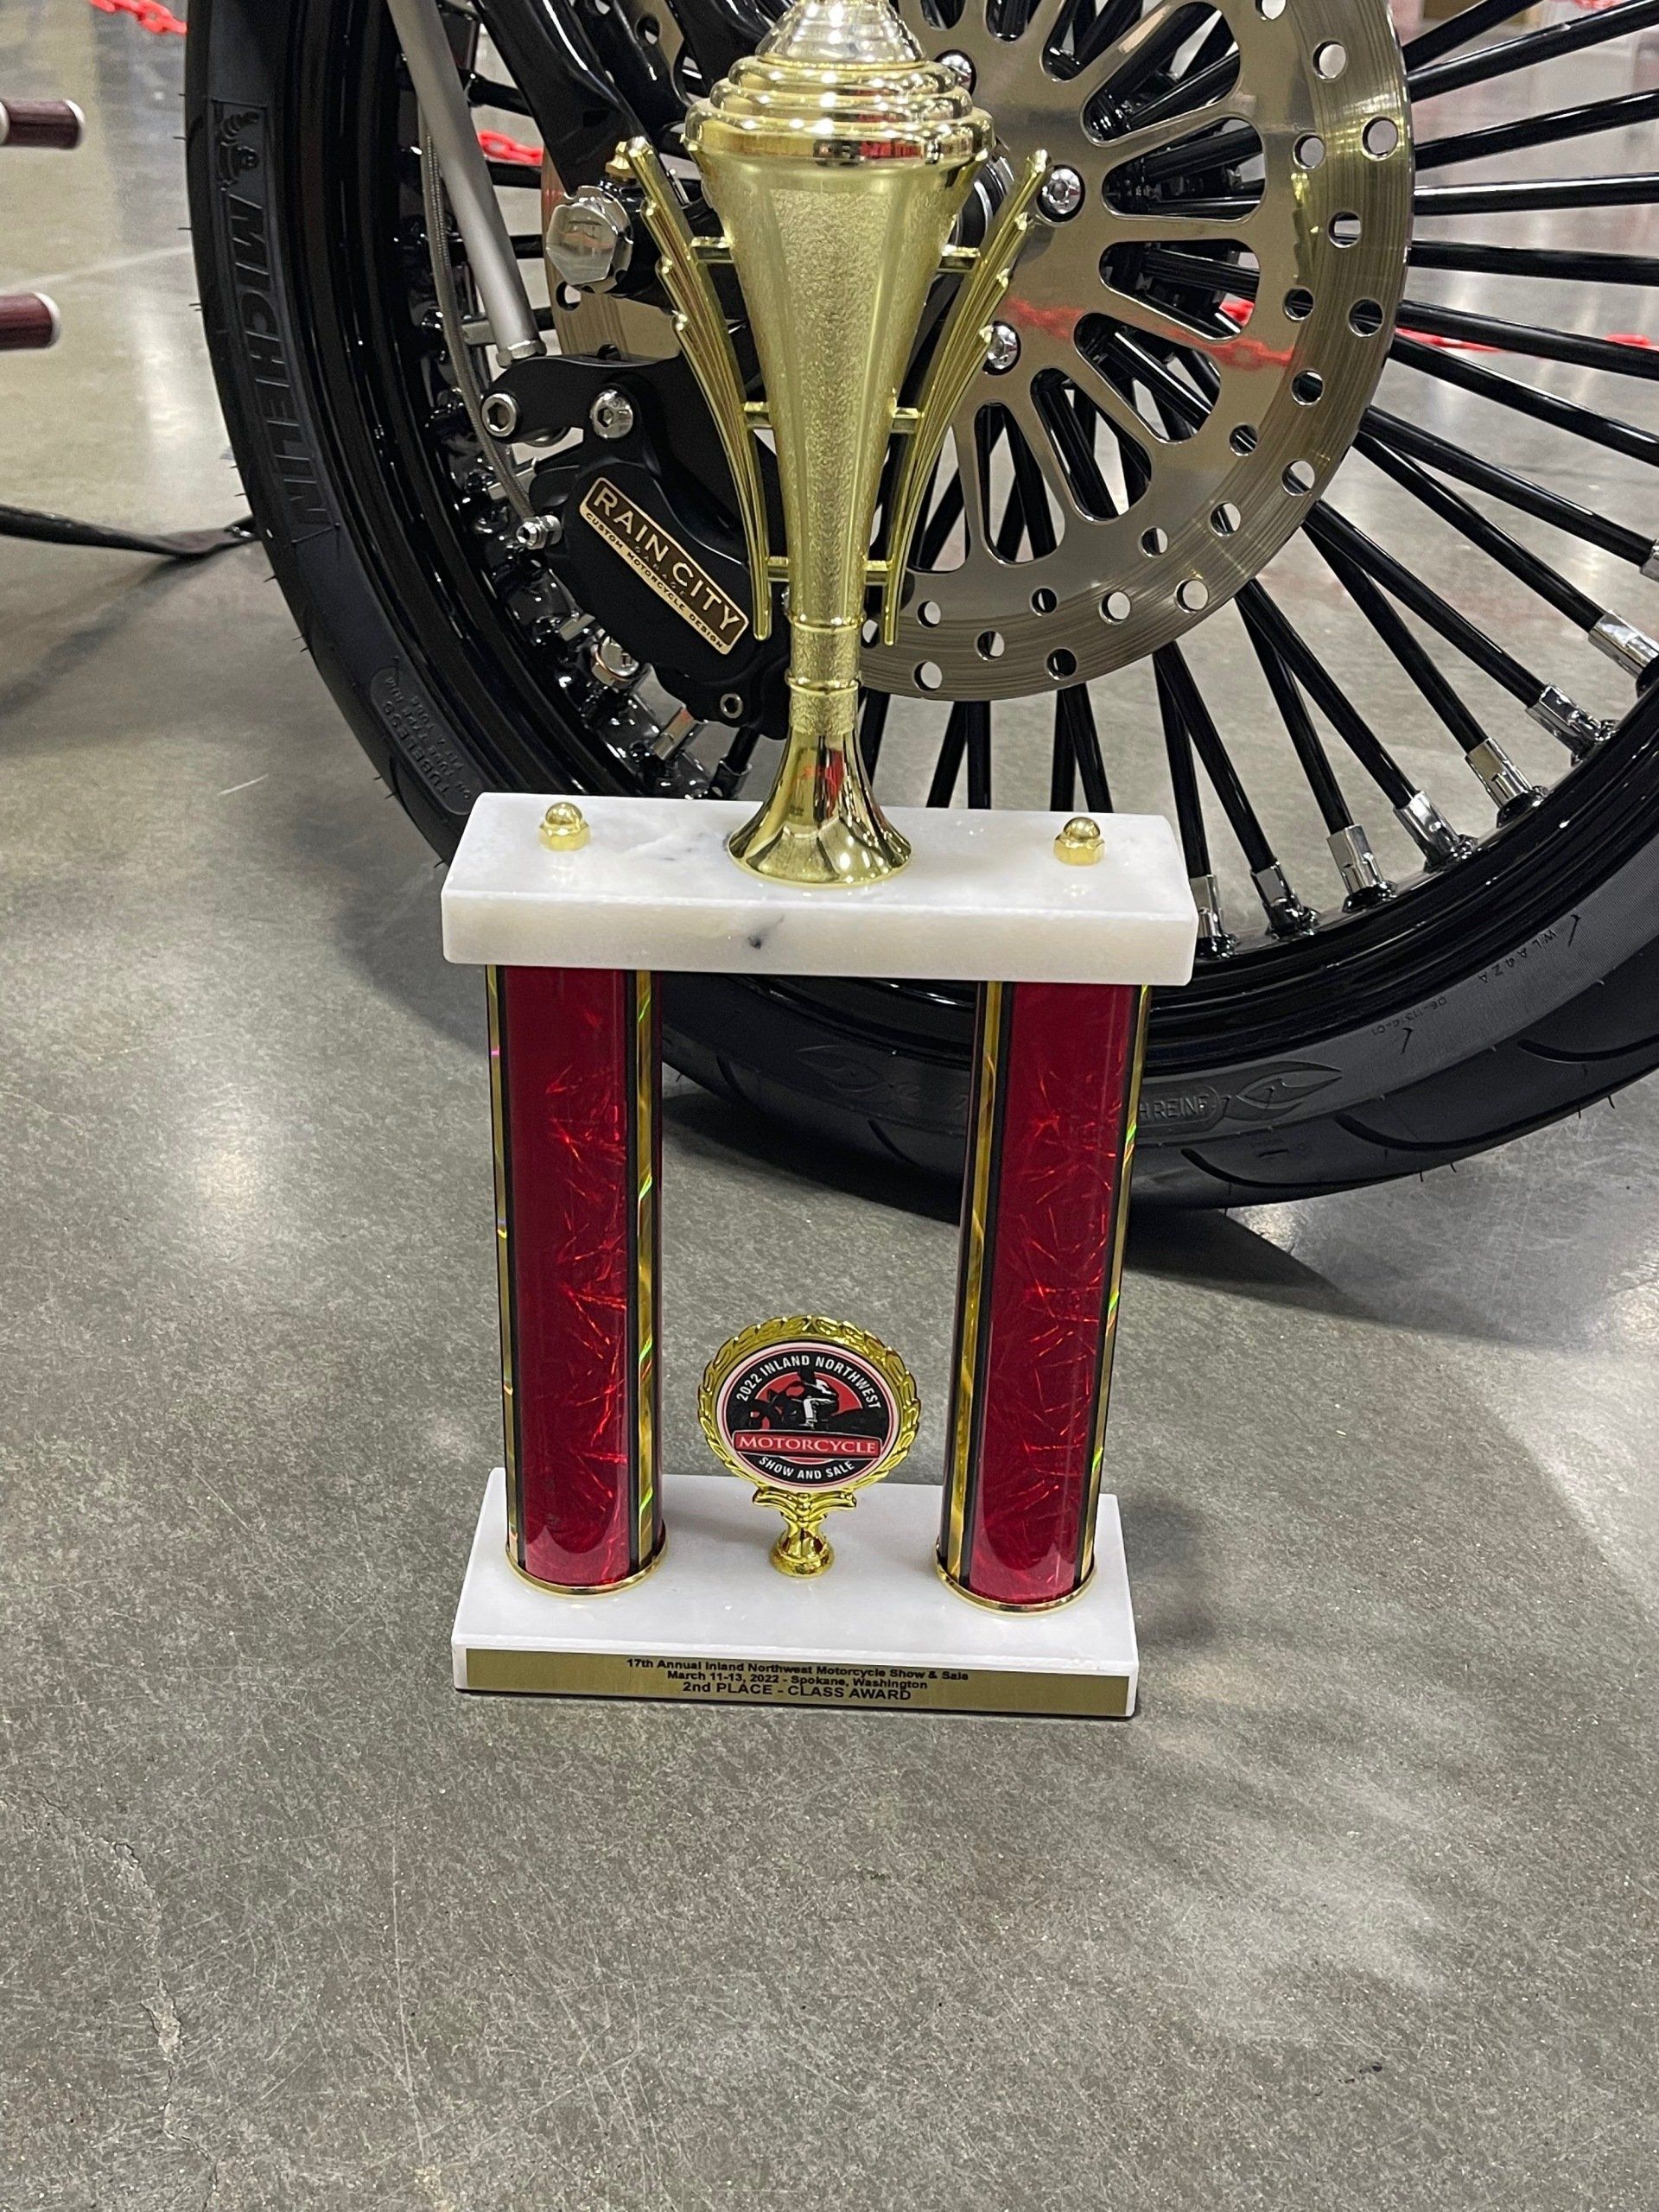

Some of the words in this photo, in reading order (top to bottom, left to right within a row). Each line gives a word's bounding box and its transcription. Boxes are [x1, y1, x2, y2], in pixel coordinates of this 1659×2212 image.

[228, 194, 330, 524] MICHELIN
[593, 486, 670, 563] RAIN
[672, 562, 741, 632] CITY
[586, 512, 624, 550] CUSTOM
[626, 551, 686, 611] MOTORCYCLE
[690, 613, 724, 649] DESIGN
[736, 1373, 764, 1402] 2022
[760, 1354, 810, 1377] INLAND
[815, 1356, 881, 1410] NORTHWEST
[739, 1435, 876, 1454] MOTORCYCLE
[758, 1456, 794, 1478] SHOW
[797, 1465, 823, 1480] AND
[827, 1460, 856, 1478] SALE
[626, 1658, 654, 1669] 17th
[657, 1659, 702, 1670] Annual
[705, 1661, 745, 1672] Inland
[747, 1662, 813, 1674] Northwest
[817, 1666, 886, 1678] Motorcycle
[889, 1669, 926, 1680] Show
[928, 1670, 938, 1679] &
[942, 1671, 969, 1681] Sale
[667, 1670, 706, 1681] March
[710, 1672, 747, 1683] 11-13,
[750, 1674, 779, 1683] 2022
[791, 1675, 849, 1688] Spokane,
[853, 1677, 928, 1690] Washington
[683, 1681, 711, 1693] 2nd
[716, 1682, 773, 1694] PLACE
[788, 1686, 845, 1698] CLASS
[849, 1688, 912, 1700] AWARD
